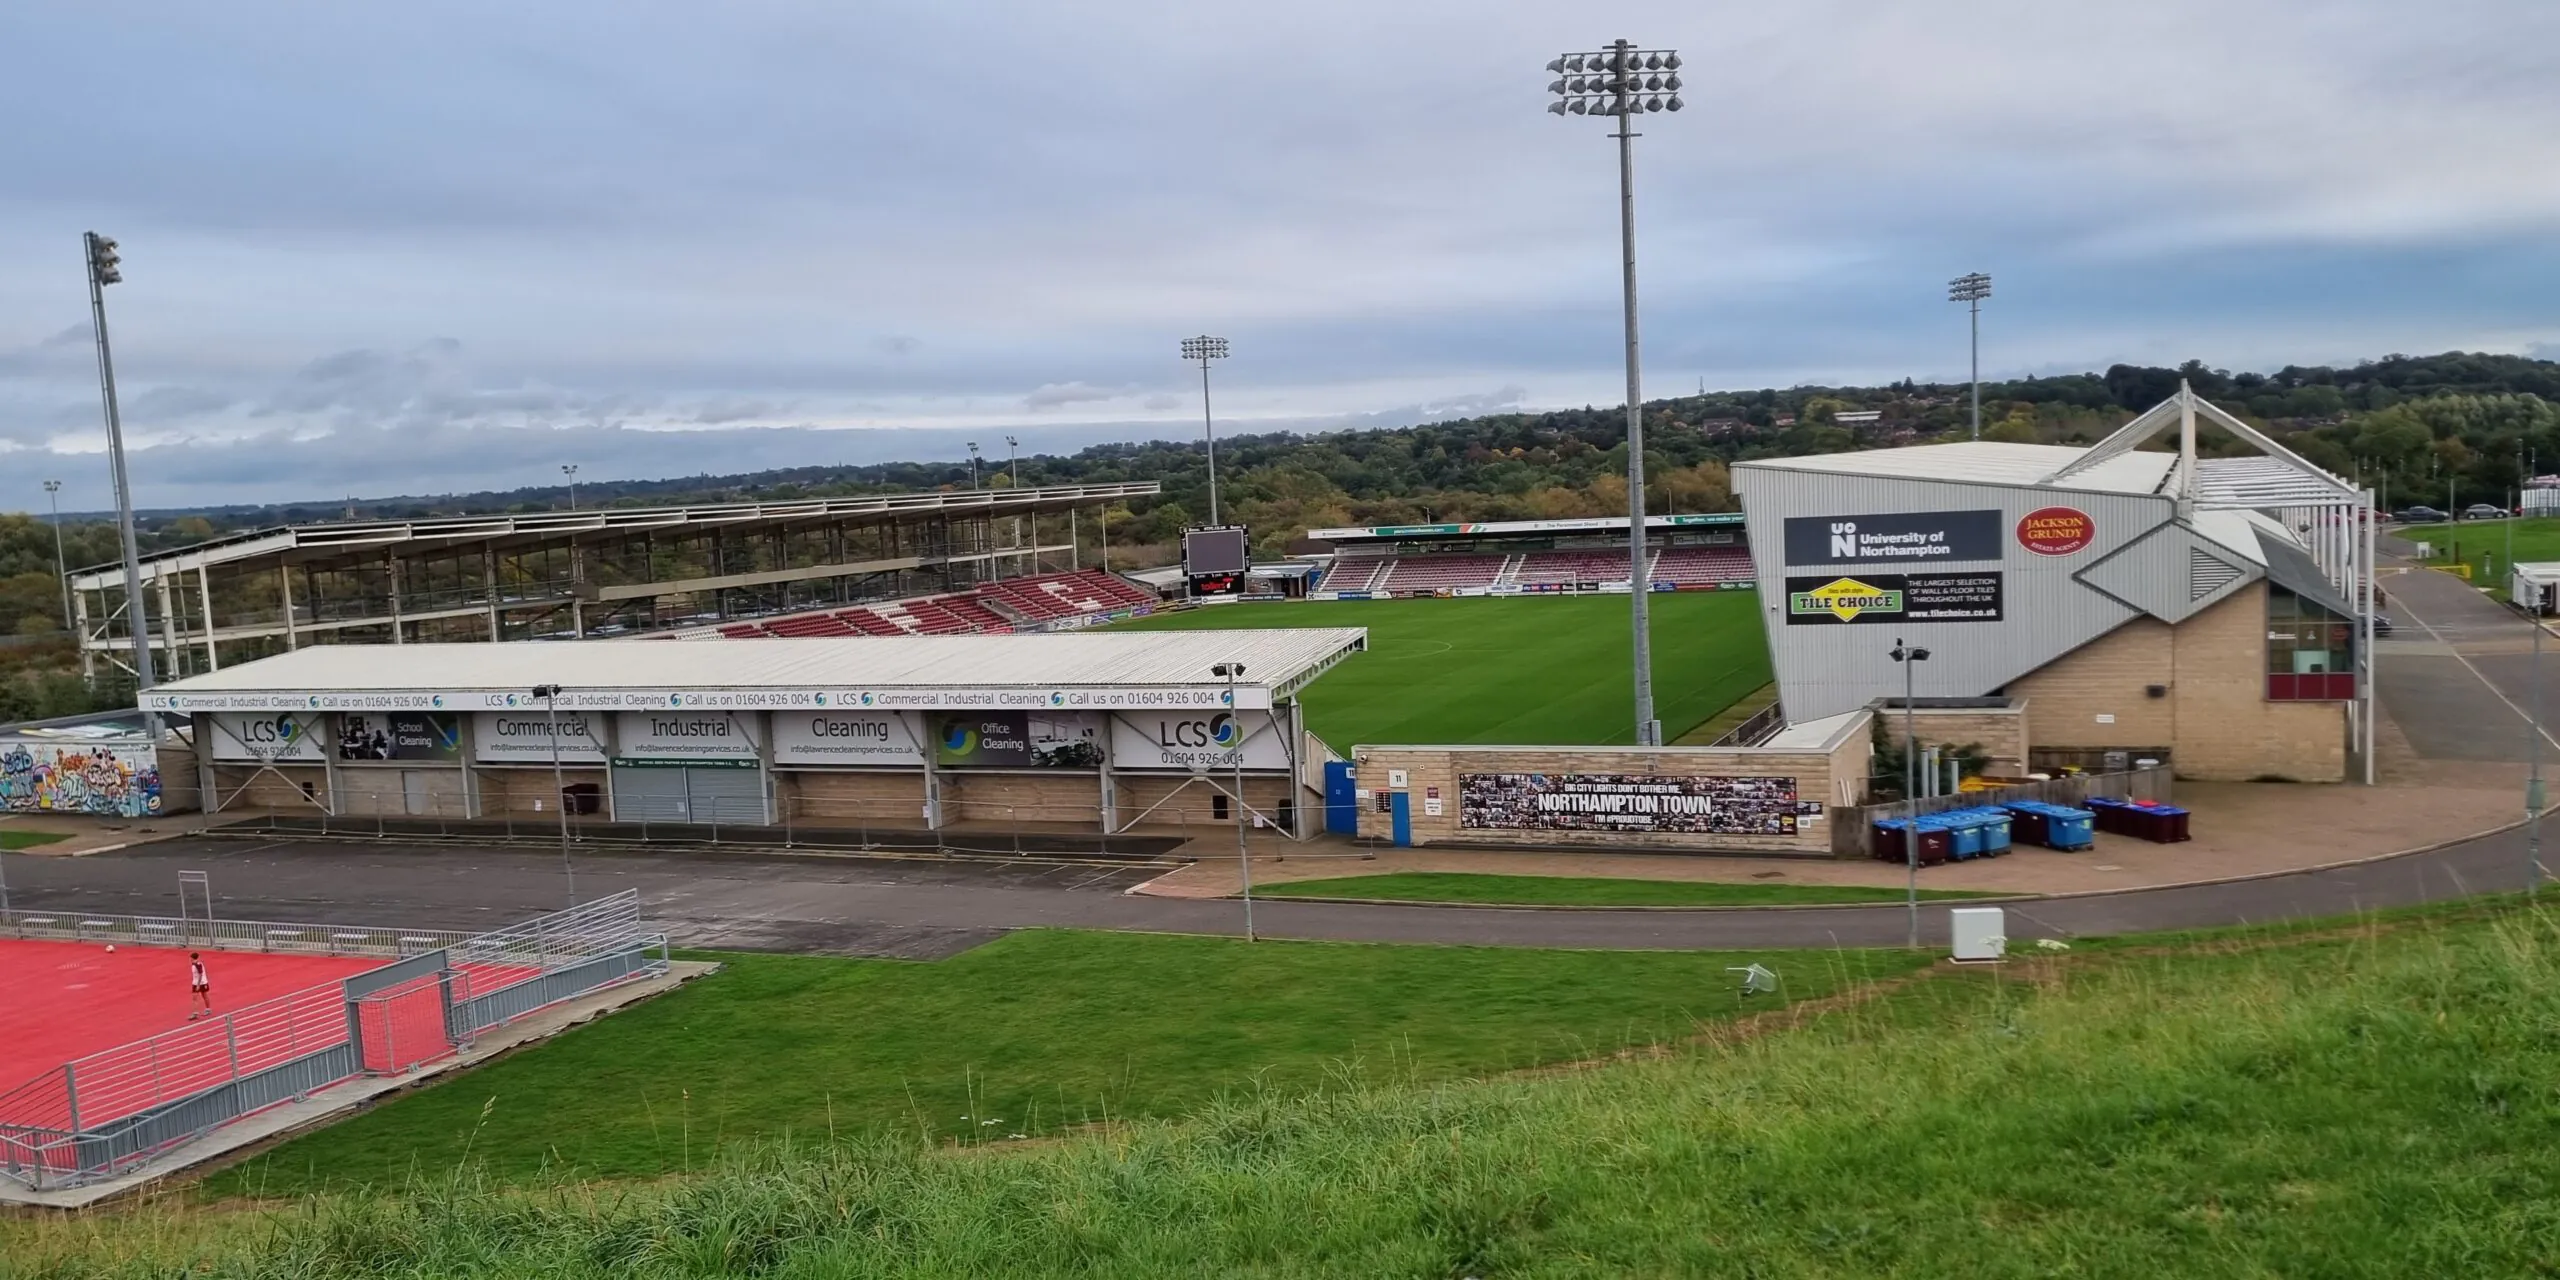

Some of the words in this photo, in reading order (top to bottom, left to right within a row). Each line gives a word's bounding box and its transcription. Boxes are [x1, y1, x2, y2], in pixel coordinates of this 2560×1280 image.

[2027, 518, 2084, 530] JACKSON
[1860, 532, 1926, 544] University
[1930, 531, 1944, 542] of
[2028, 528, 2082, 539] GRUNDY
[1832, 535, 1856, 557] N
[1860, 545, 1950, 556] Northampton
[2031, 542, 2054, 552] ESTATE
[2056, 540, 2080, 550] AGENTS
[1800, 598, 1832, 608] TILE
[1838, 596, 1892, 608] CHOICE
[1908, 608, 1996, 618] www.tilechoice.co.uk
[151, 697, 166, 708] LCS
[182, 697, 227, 708] Commercial
[231, 696, 268, 707] Industrial
[272, 697, 306, 709] Cleaning
[323, 696, 338, 706] Call
[340, 698, 350, 706] us
[353, 698, 363, 706] on
[366, 696, 391, 706] 01604
[394, 695, 410, 706] 926
[412, 695, 429, 706] 004
[484, 695, 502, 706] LCS
[521, 695, 574, 706] Commercial
[578, 695, 621, 706] Industrial
[626, 694, 666, 708] Cleaning
[686, 694, 702, 705] Call
[706, 696, 717, 705] us
[720, 696, 732, 705] on
[736, 694, 766, 705] 01604
[769, 694, 788, 704] 926
[791, 694, 809, 704] 004
[837, 694, 856, 705] LCS
[878, 693, 938, 704] Commercial
[944, 693, 994, 704] Industrial
[1000, 693, 1046, 706] Cleaning
[1069, 692, 1088, 704] Call
[1094, 694, 1106, 704] us
[1110, 694, 1124, 704] on
[1129, 692, 1162, 704] 01604
[1168, 692, 1188, 704] 926
[1193, 692, 1214, 704] 004
[243, 720, 276, 742] LCS
[398, 722, 423, 732] School
[497, 718, 588, 736] Commercial
[651, 718, 730, 736] Industrial
[812, 718, 888, 741] Cleaning
[982, 722, 1010, 734] Office
[1160, 721, 1208, 748] LCS
[399, 736, 432, 748] Cleaning
[982, 738, 1024, 751] Cleaning
[635, 744, 750, 754] info@lawrencecleaningservices.co.uk
[791, 744, 914, 754] info@lawrencecleaningservices.co.uk
[1162, 752, 1194, 764] 01604
[1198, 752, 1218, 764] 926
[1395, 774, 1402, 782] 11
[1564, 784, 1576, 792] BIG
[1577, 784, 1592, 792] CITY
[1593, 784, 1617, 792] LIGHTS
[1618, 785, 1639, 793] DON'T
[1640, 785, 1668, 794] BOTHER
[1538, 794, 1658, 813] NORTHAMPTON
[1662, 796, 1712, 814] TOWN
[1595, 815, 1606, 824] I'M
[1607, 815, 1652, 824] #PROUDTOBE
